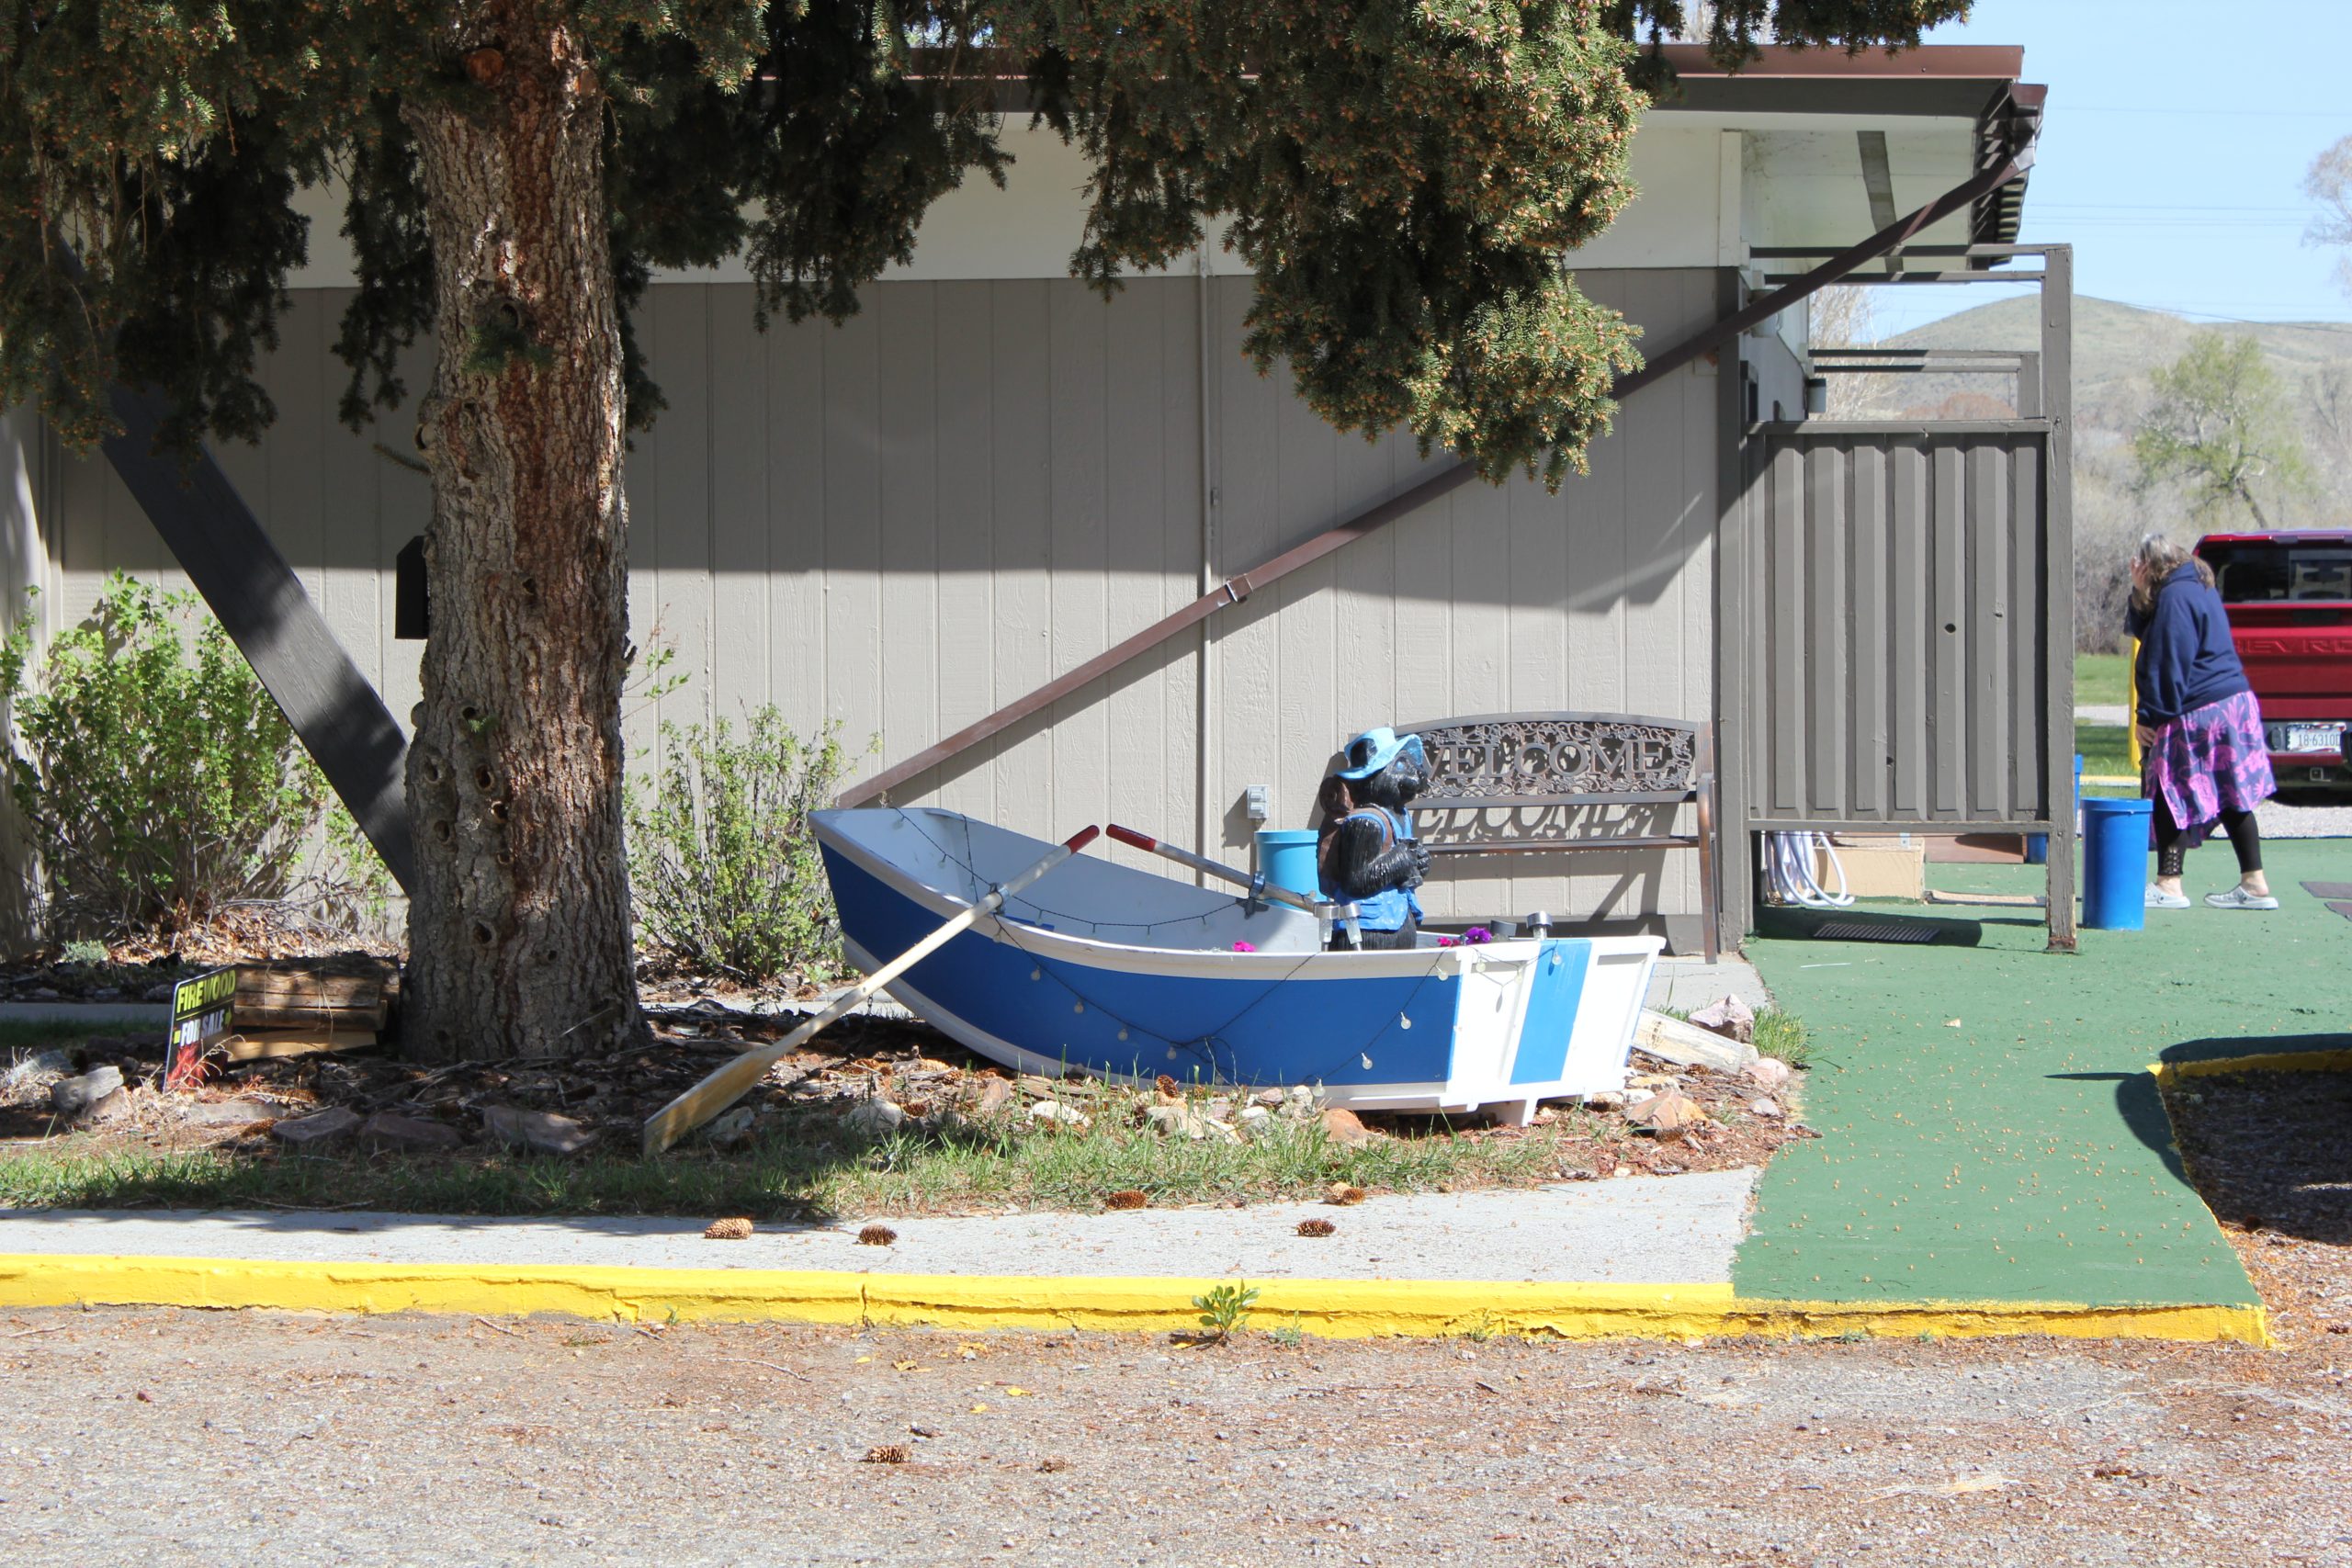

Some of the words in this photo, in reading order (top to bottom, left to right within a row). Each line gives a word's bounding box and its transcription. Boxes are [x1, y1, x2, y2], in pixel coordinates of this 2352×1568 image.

[176, 970, 236, 1014] FIREWOOD
[180, 1019, 201, 1046] FOR
[201, 1009, 225, 1039] SALE
